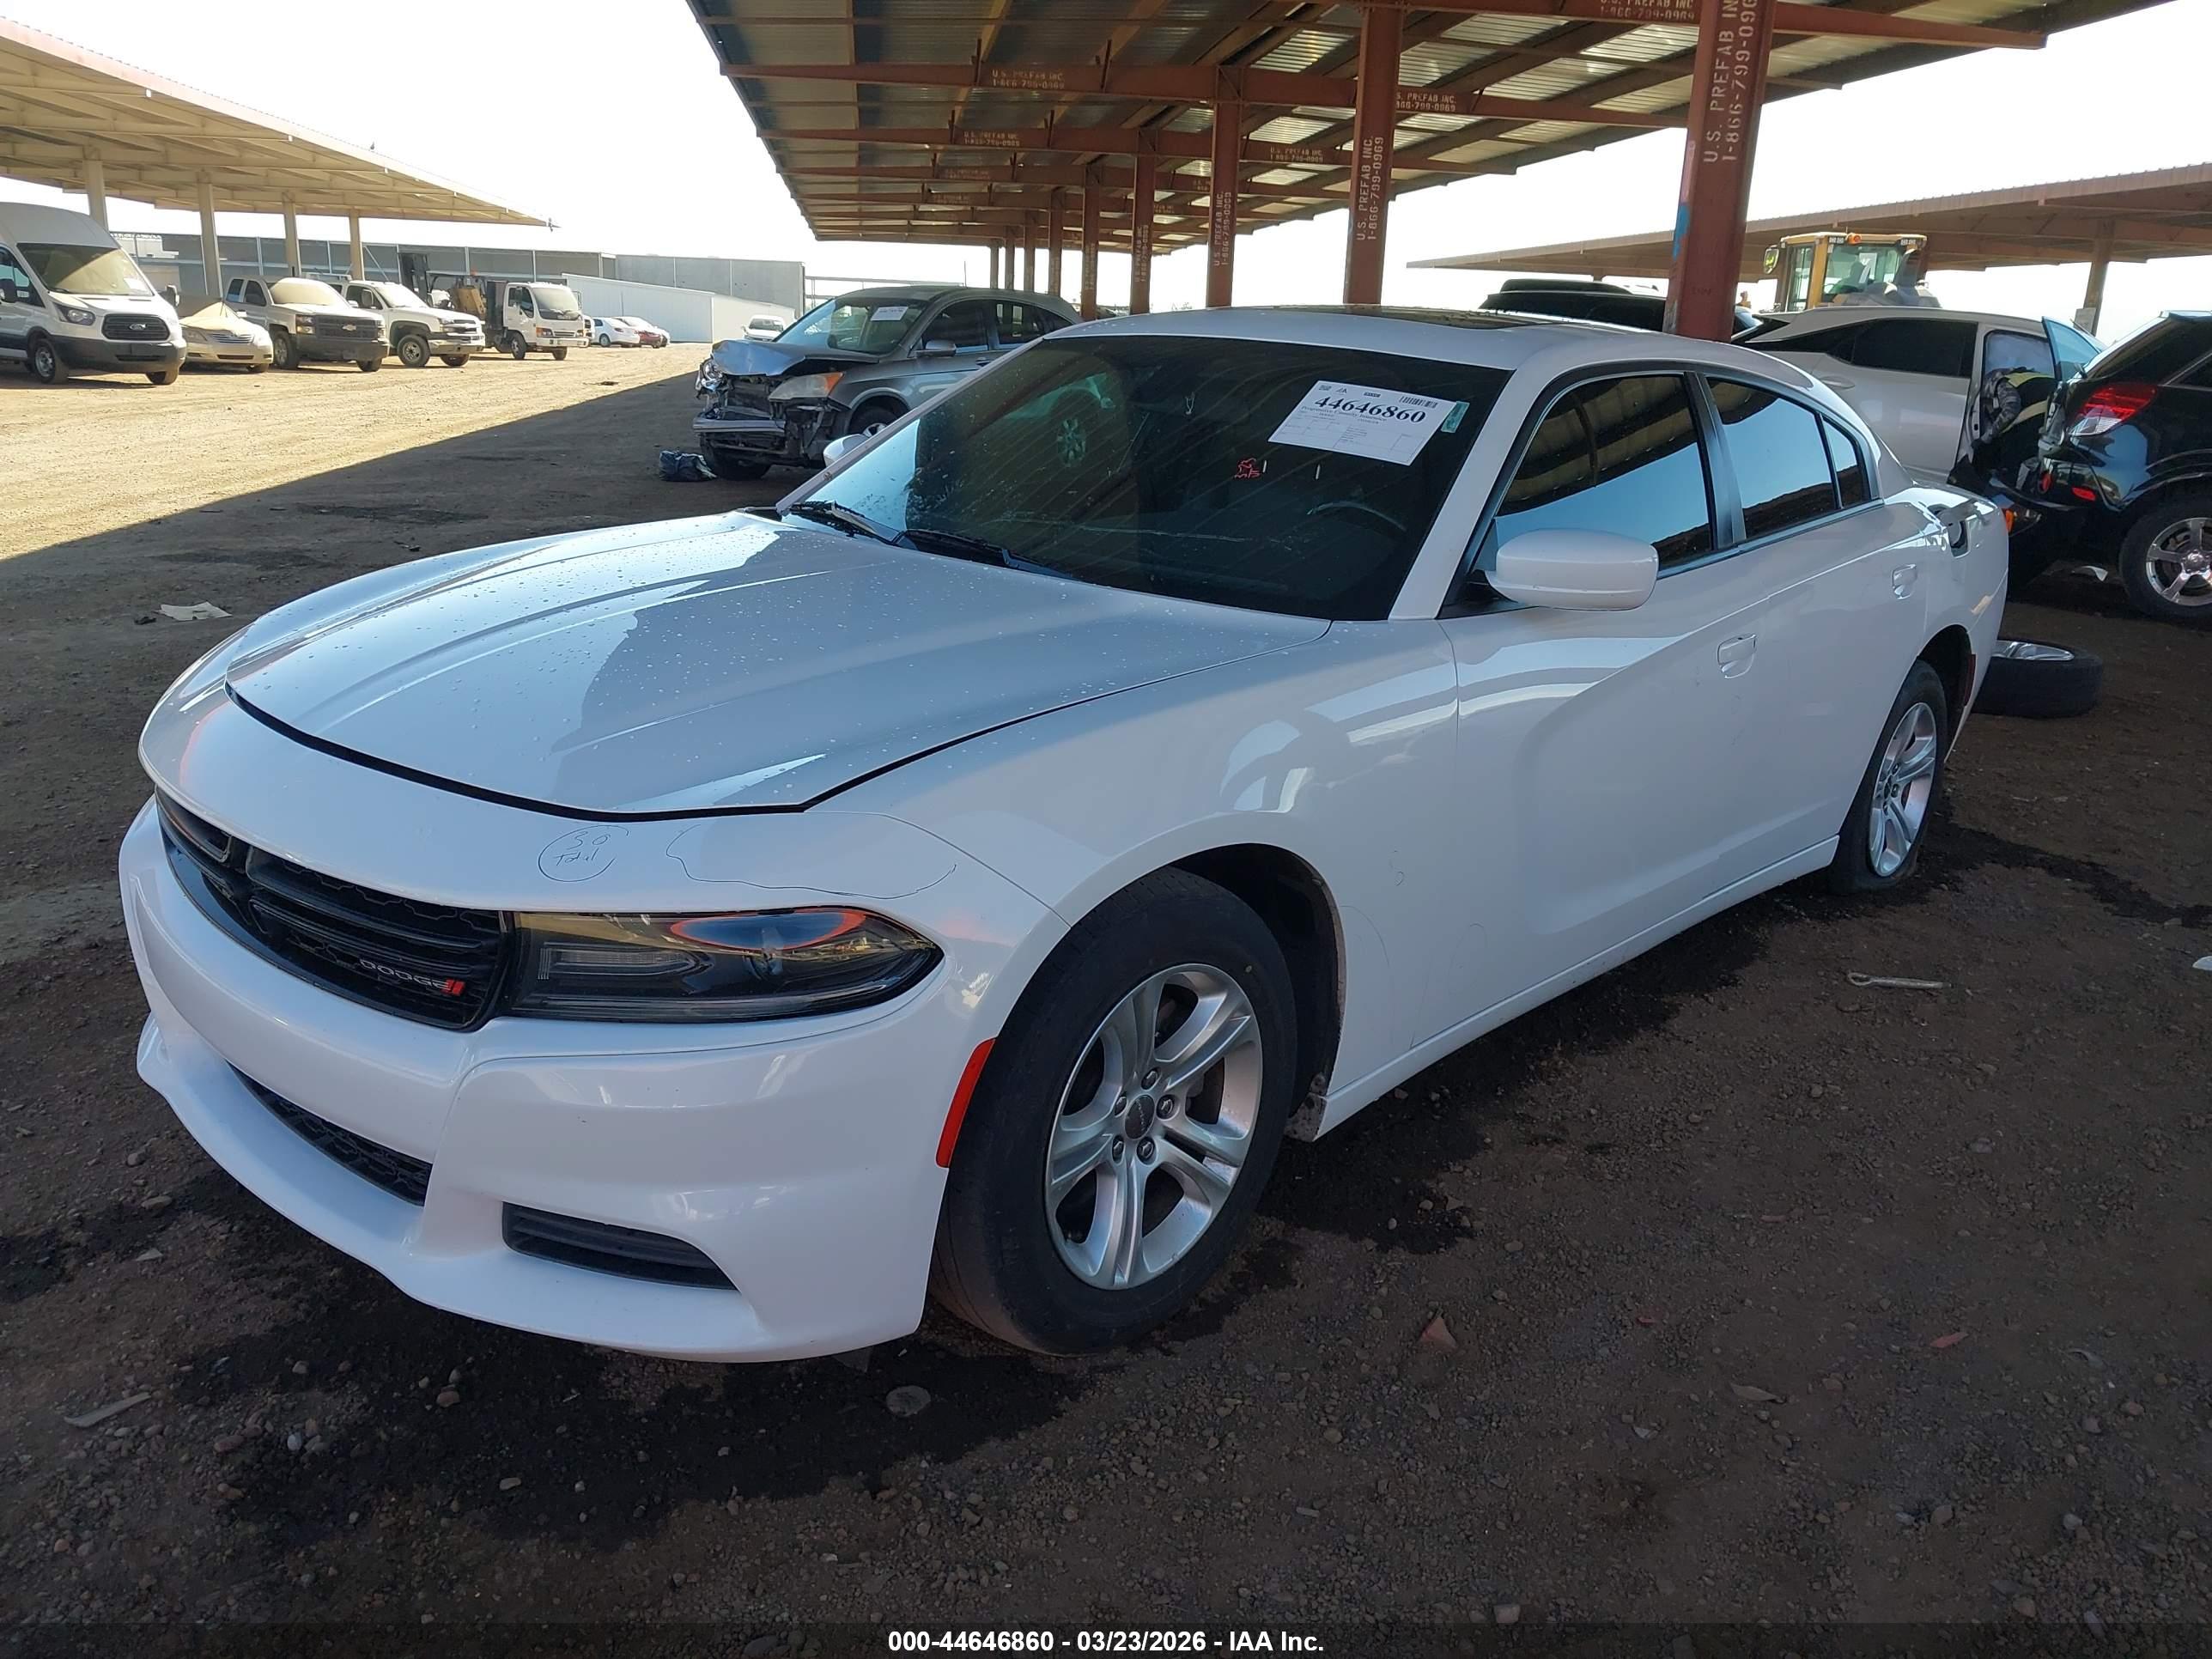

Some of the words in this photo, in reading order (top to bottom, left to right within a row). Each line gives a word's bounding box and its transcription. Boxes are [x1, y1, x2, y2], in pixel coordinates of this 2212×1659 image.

[1710, 30, 1735, 112] PREFAB
[1407, 92, 1438, 102] PREFAB
[1362, 136, 1374, 159] INC.
[1704, 125, 1723, 163] U.S.
[1358, 166, 1371, 211] PREFAB
[1367, 136, 1384, 240] 1-866-799-0969
[1357, 218, 1368, 241] U.S.
[1315, 396, 1426, 424] 44646860
[359, 957, 451, 991] DODGE
